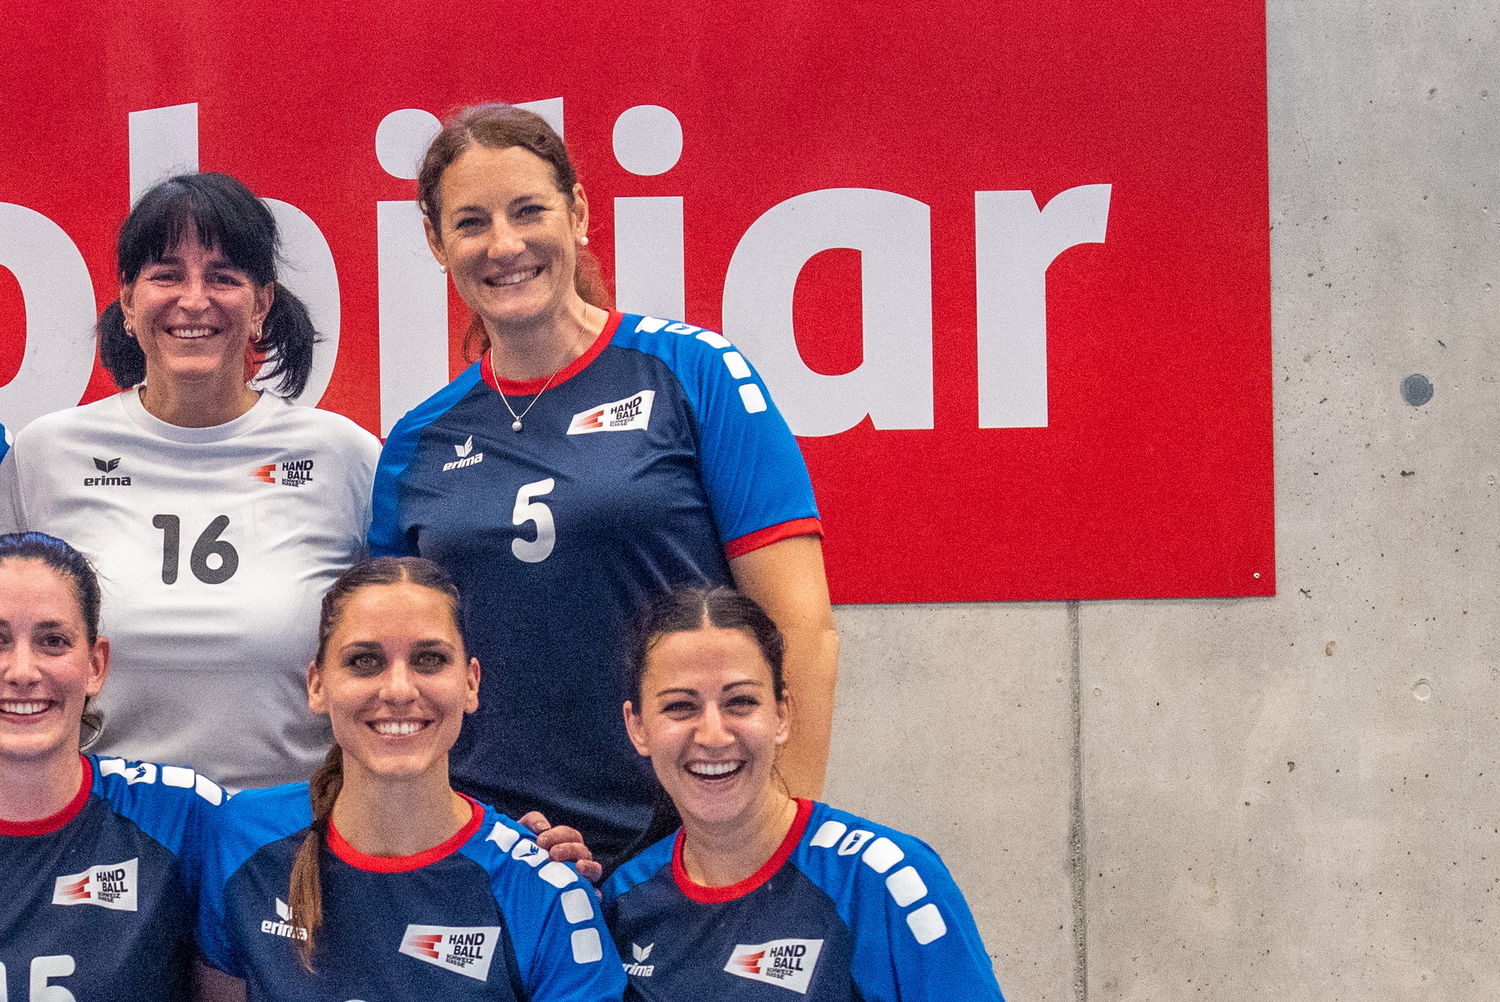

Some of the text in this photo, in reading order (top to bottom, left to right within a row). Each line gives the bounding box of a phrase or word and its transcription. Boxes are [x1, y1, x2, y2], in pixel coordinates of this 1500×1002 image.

[610, 396, 642, 415] HAND
[616, 406, 642, 420] BALL
[281, 460, 314, 471] HAND
[442, 451, 484, 472] erima
[84, 475, 132, 487] erima
[287, 471, 314, 481] BALL
[511, 478, 556, 563] 5
[152, 514, 239, 585] 16
[96, 868, 126, 882] HAND
[102, 881, 128, 893] BALL
[449, 933, 485, 946] HAND
[453, 945, 483, 959] BALL
[770, 945, 807, 957] HAND
[621, 963, 655, 977] rima
[773, 957, 804, 971] BALL
